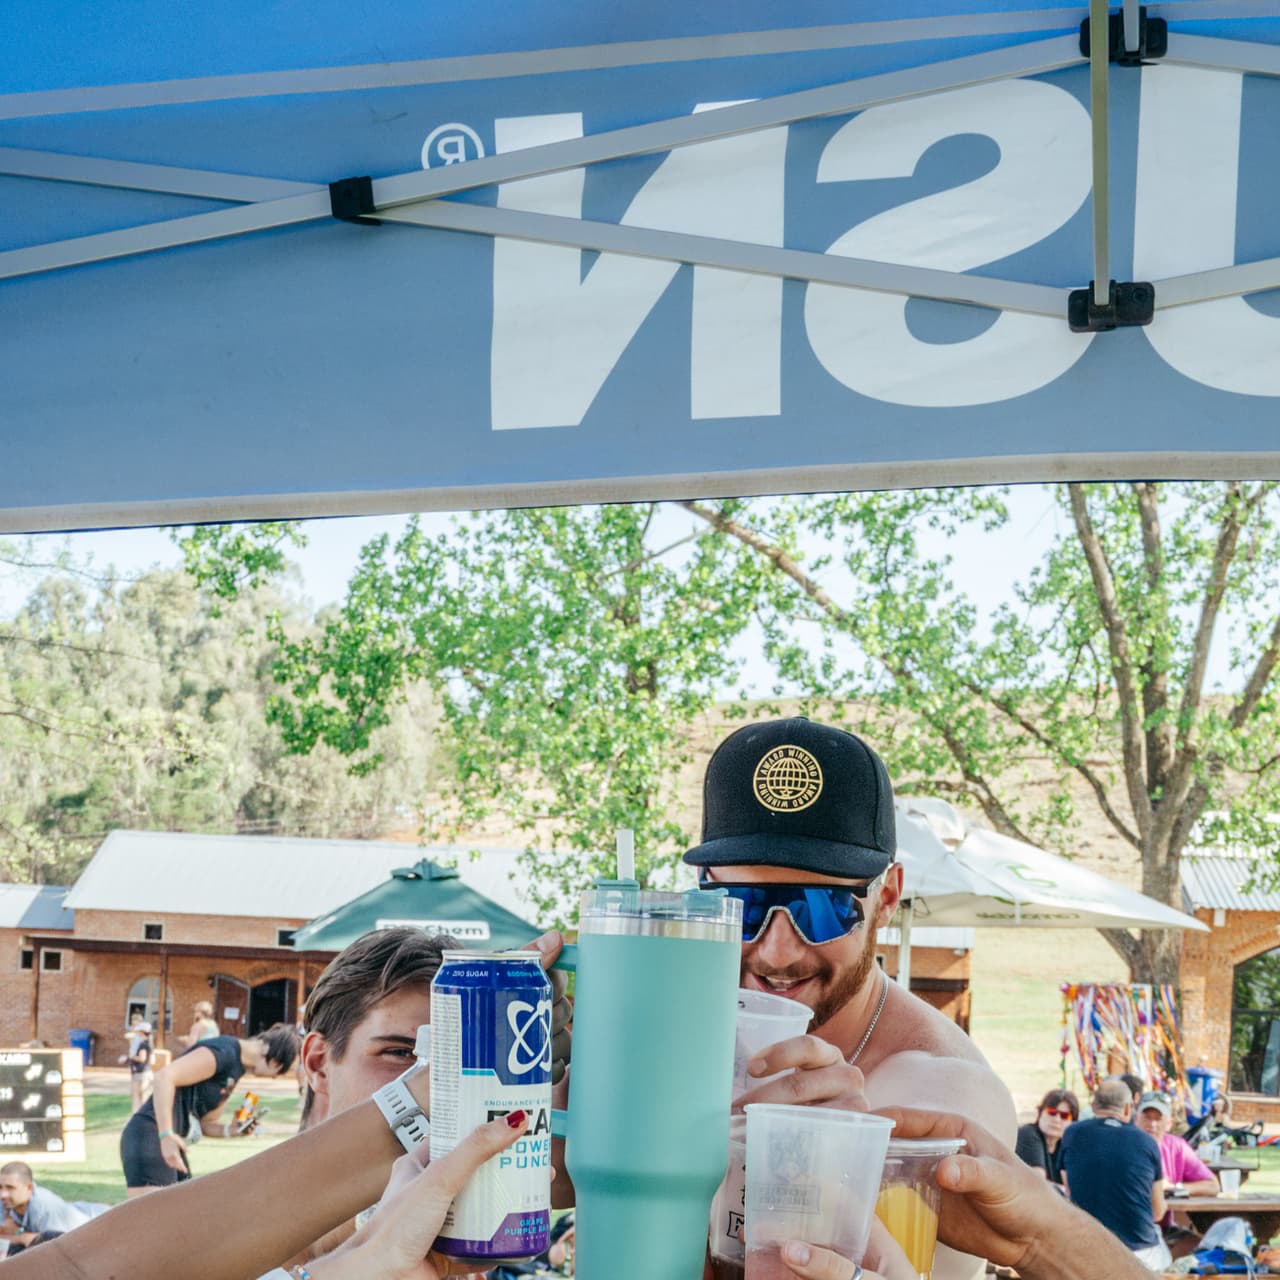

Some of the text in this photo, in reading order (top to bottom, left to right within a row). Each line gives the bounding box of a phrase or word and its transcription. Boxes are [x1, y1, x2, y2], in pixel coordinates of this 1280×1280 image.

[760, 749, 818, 777] AWARD WINNING
[759, 783, 817, 808] AWARD WINNING
[466, 969, 489, 977] SUGAR
[500, 1155, 551, 1169] PUNC
[504, 1224, 537, 1236] PURPLE
